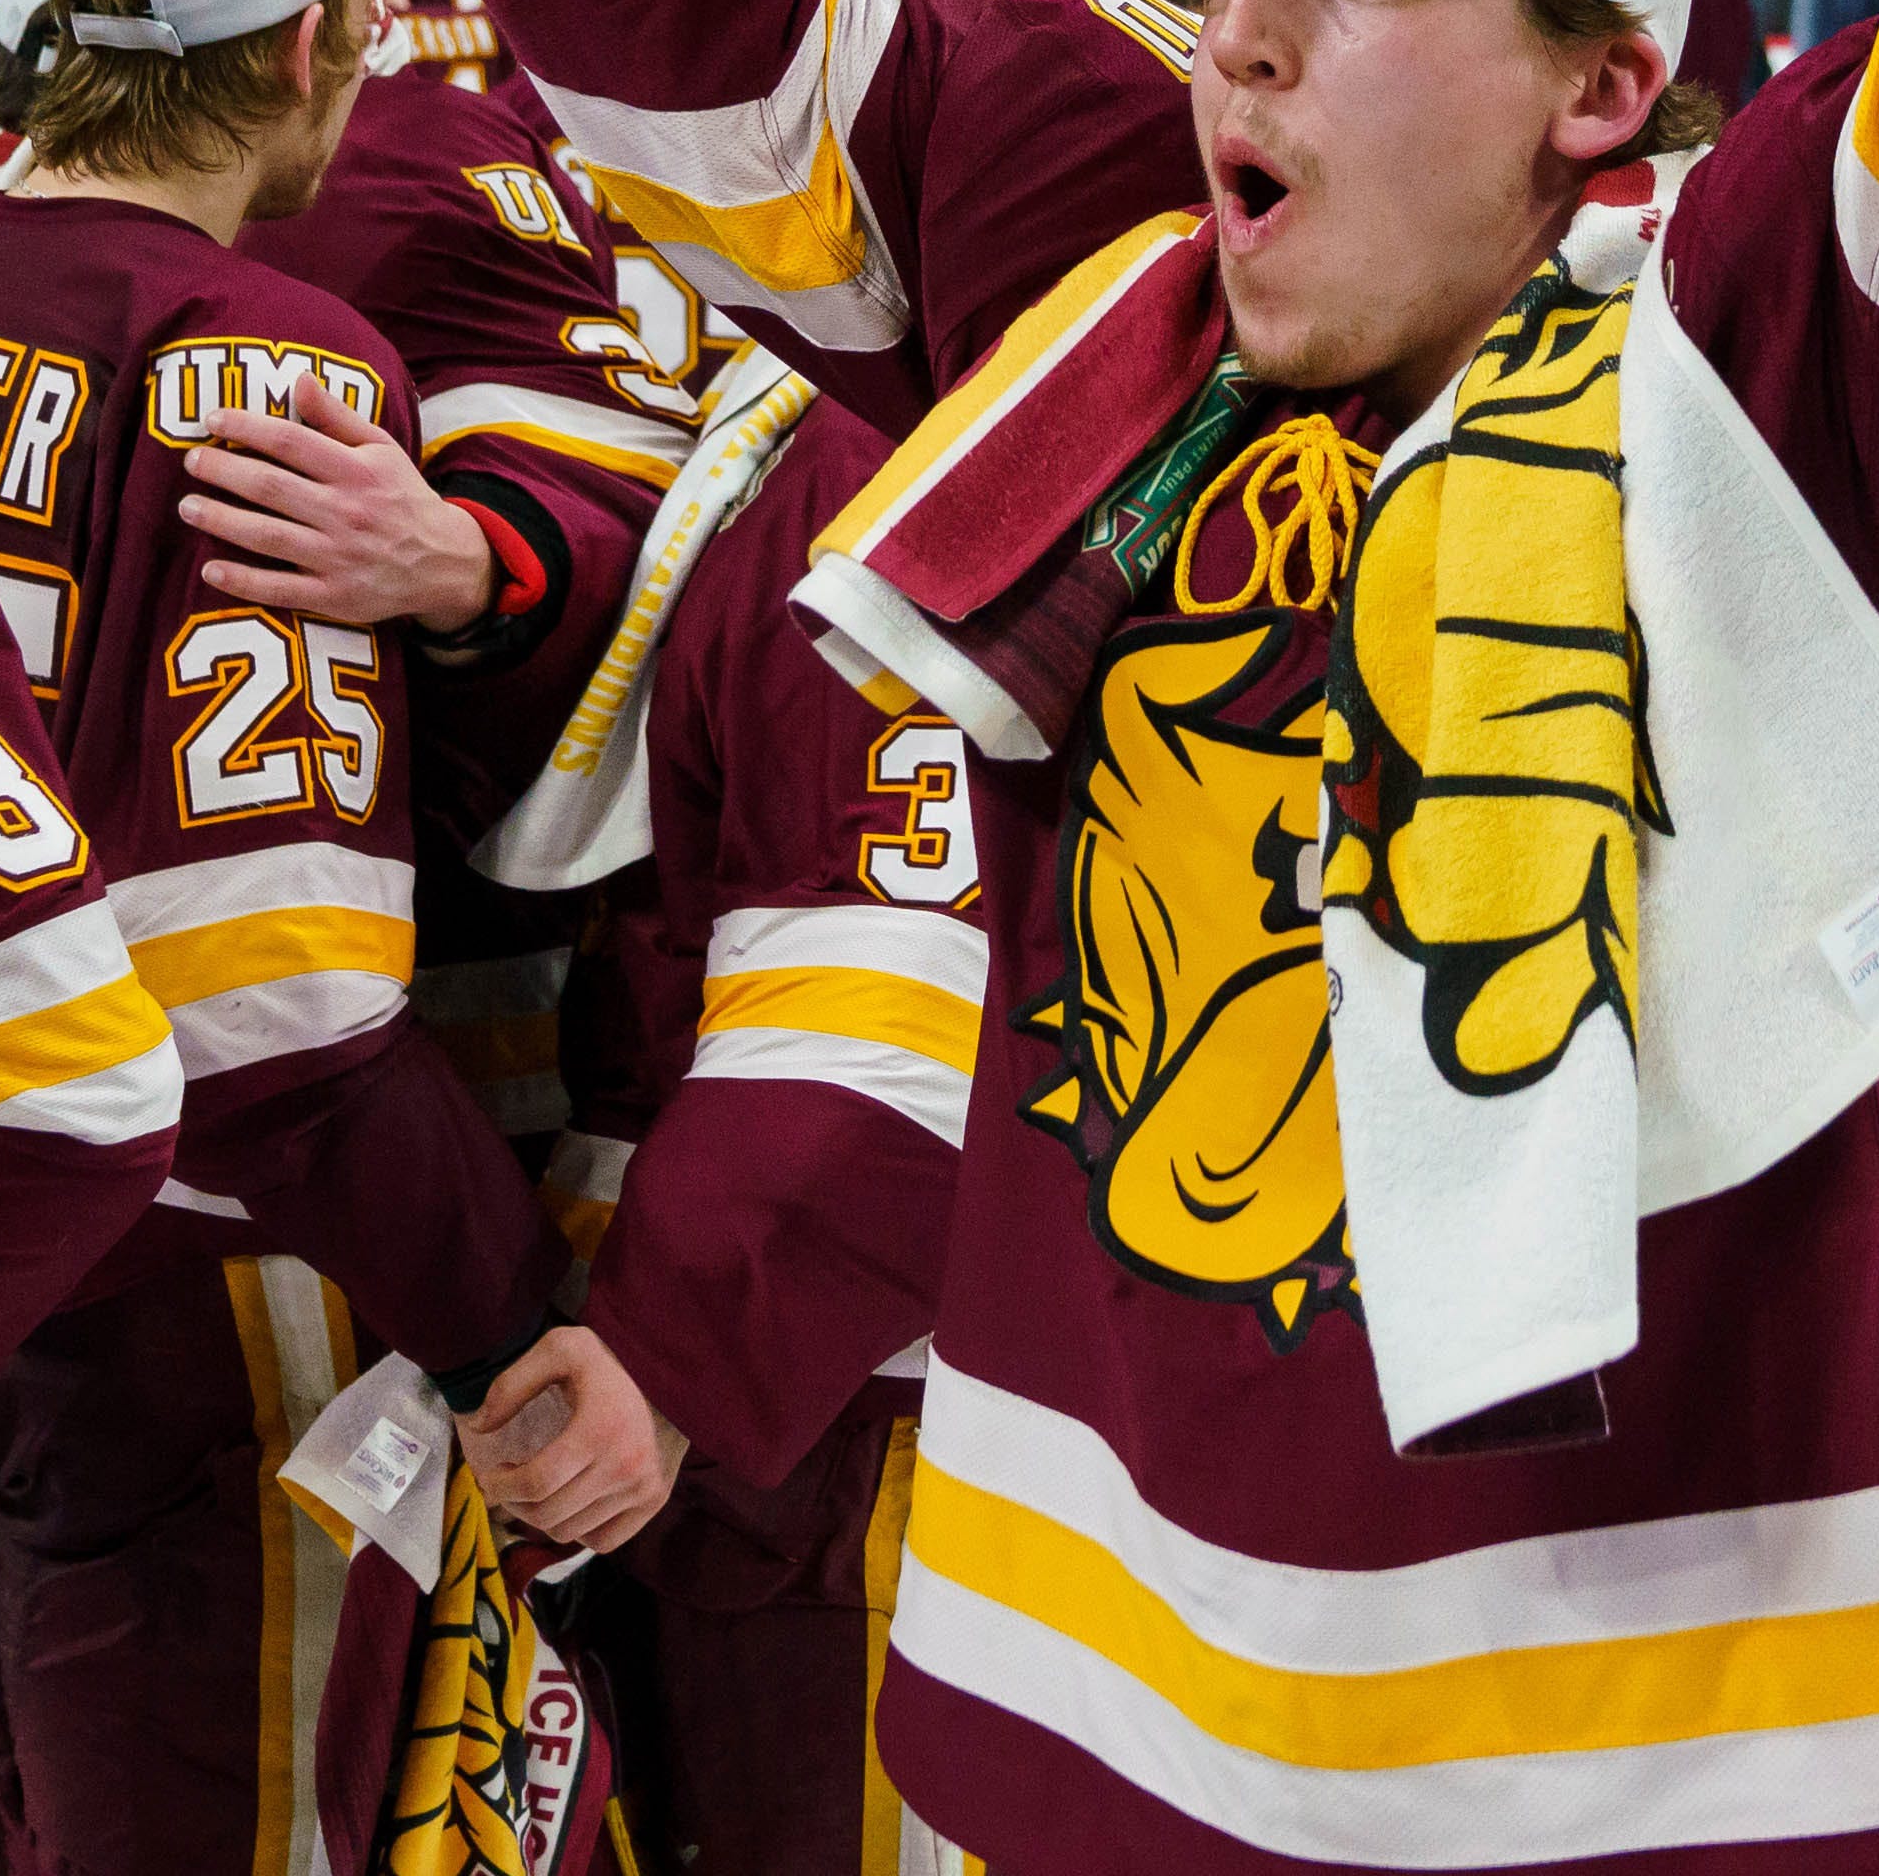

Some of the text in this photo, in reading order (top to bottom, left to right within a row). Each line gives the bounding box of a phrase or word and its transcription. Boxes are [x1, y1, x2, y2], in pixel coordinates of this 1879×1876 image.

[1160, 461, 1194, 496] PAUL
[164, 606, 387, 829] 25
[527, 1668, 580, 1769] ICE
